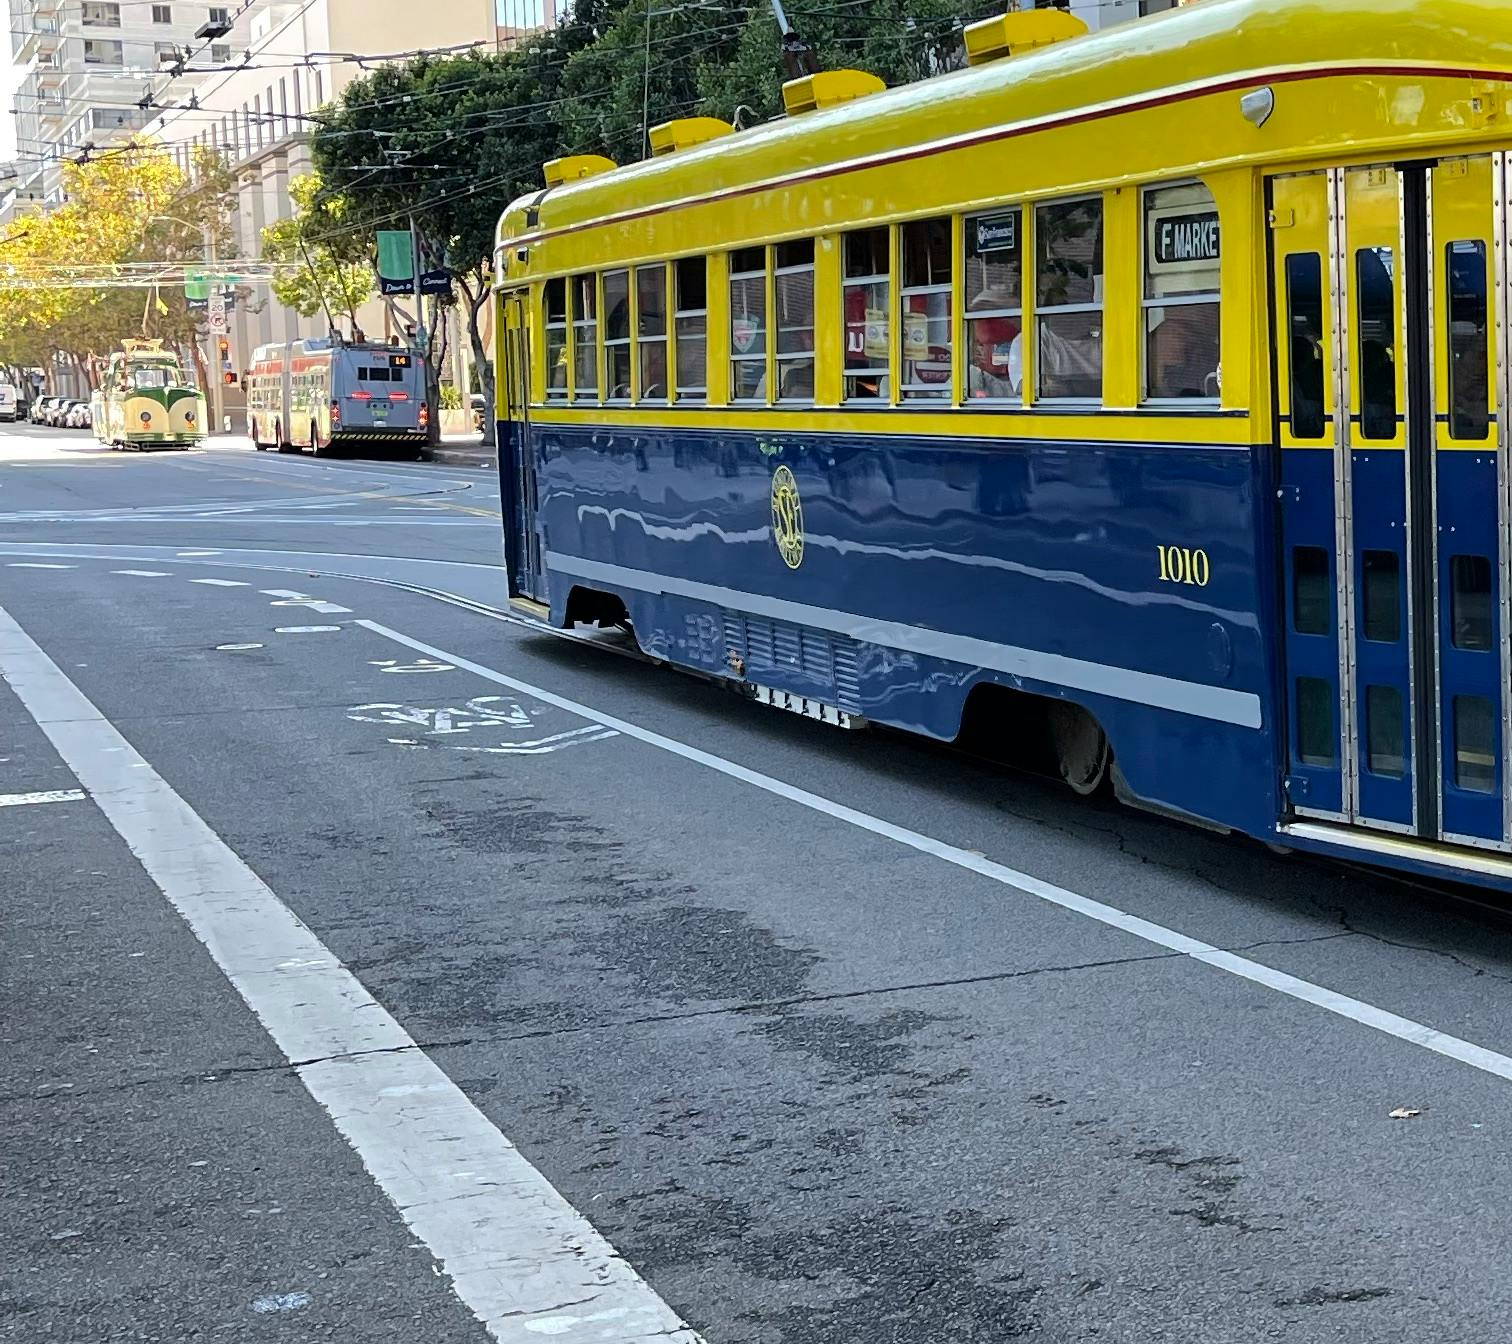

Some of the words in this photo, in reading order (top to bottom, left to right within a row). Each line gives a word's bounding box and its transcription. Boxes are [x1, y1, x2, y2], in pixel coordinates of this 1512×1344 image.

[1161, 223, 1172, 260] F
[1174, 220, 1220, 258] MARKE
[211, 304, 224, 312] 20
[395, 356, 406, 365] 14
[1156, 545, 1209, 587] 1010
